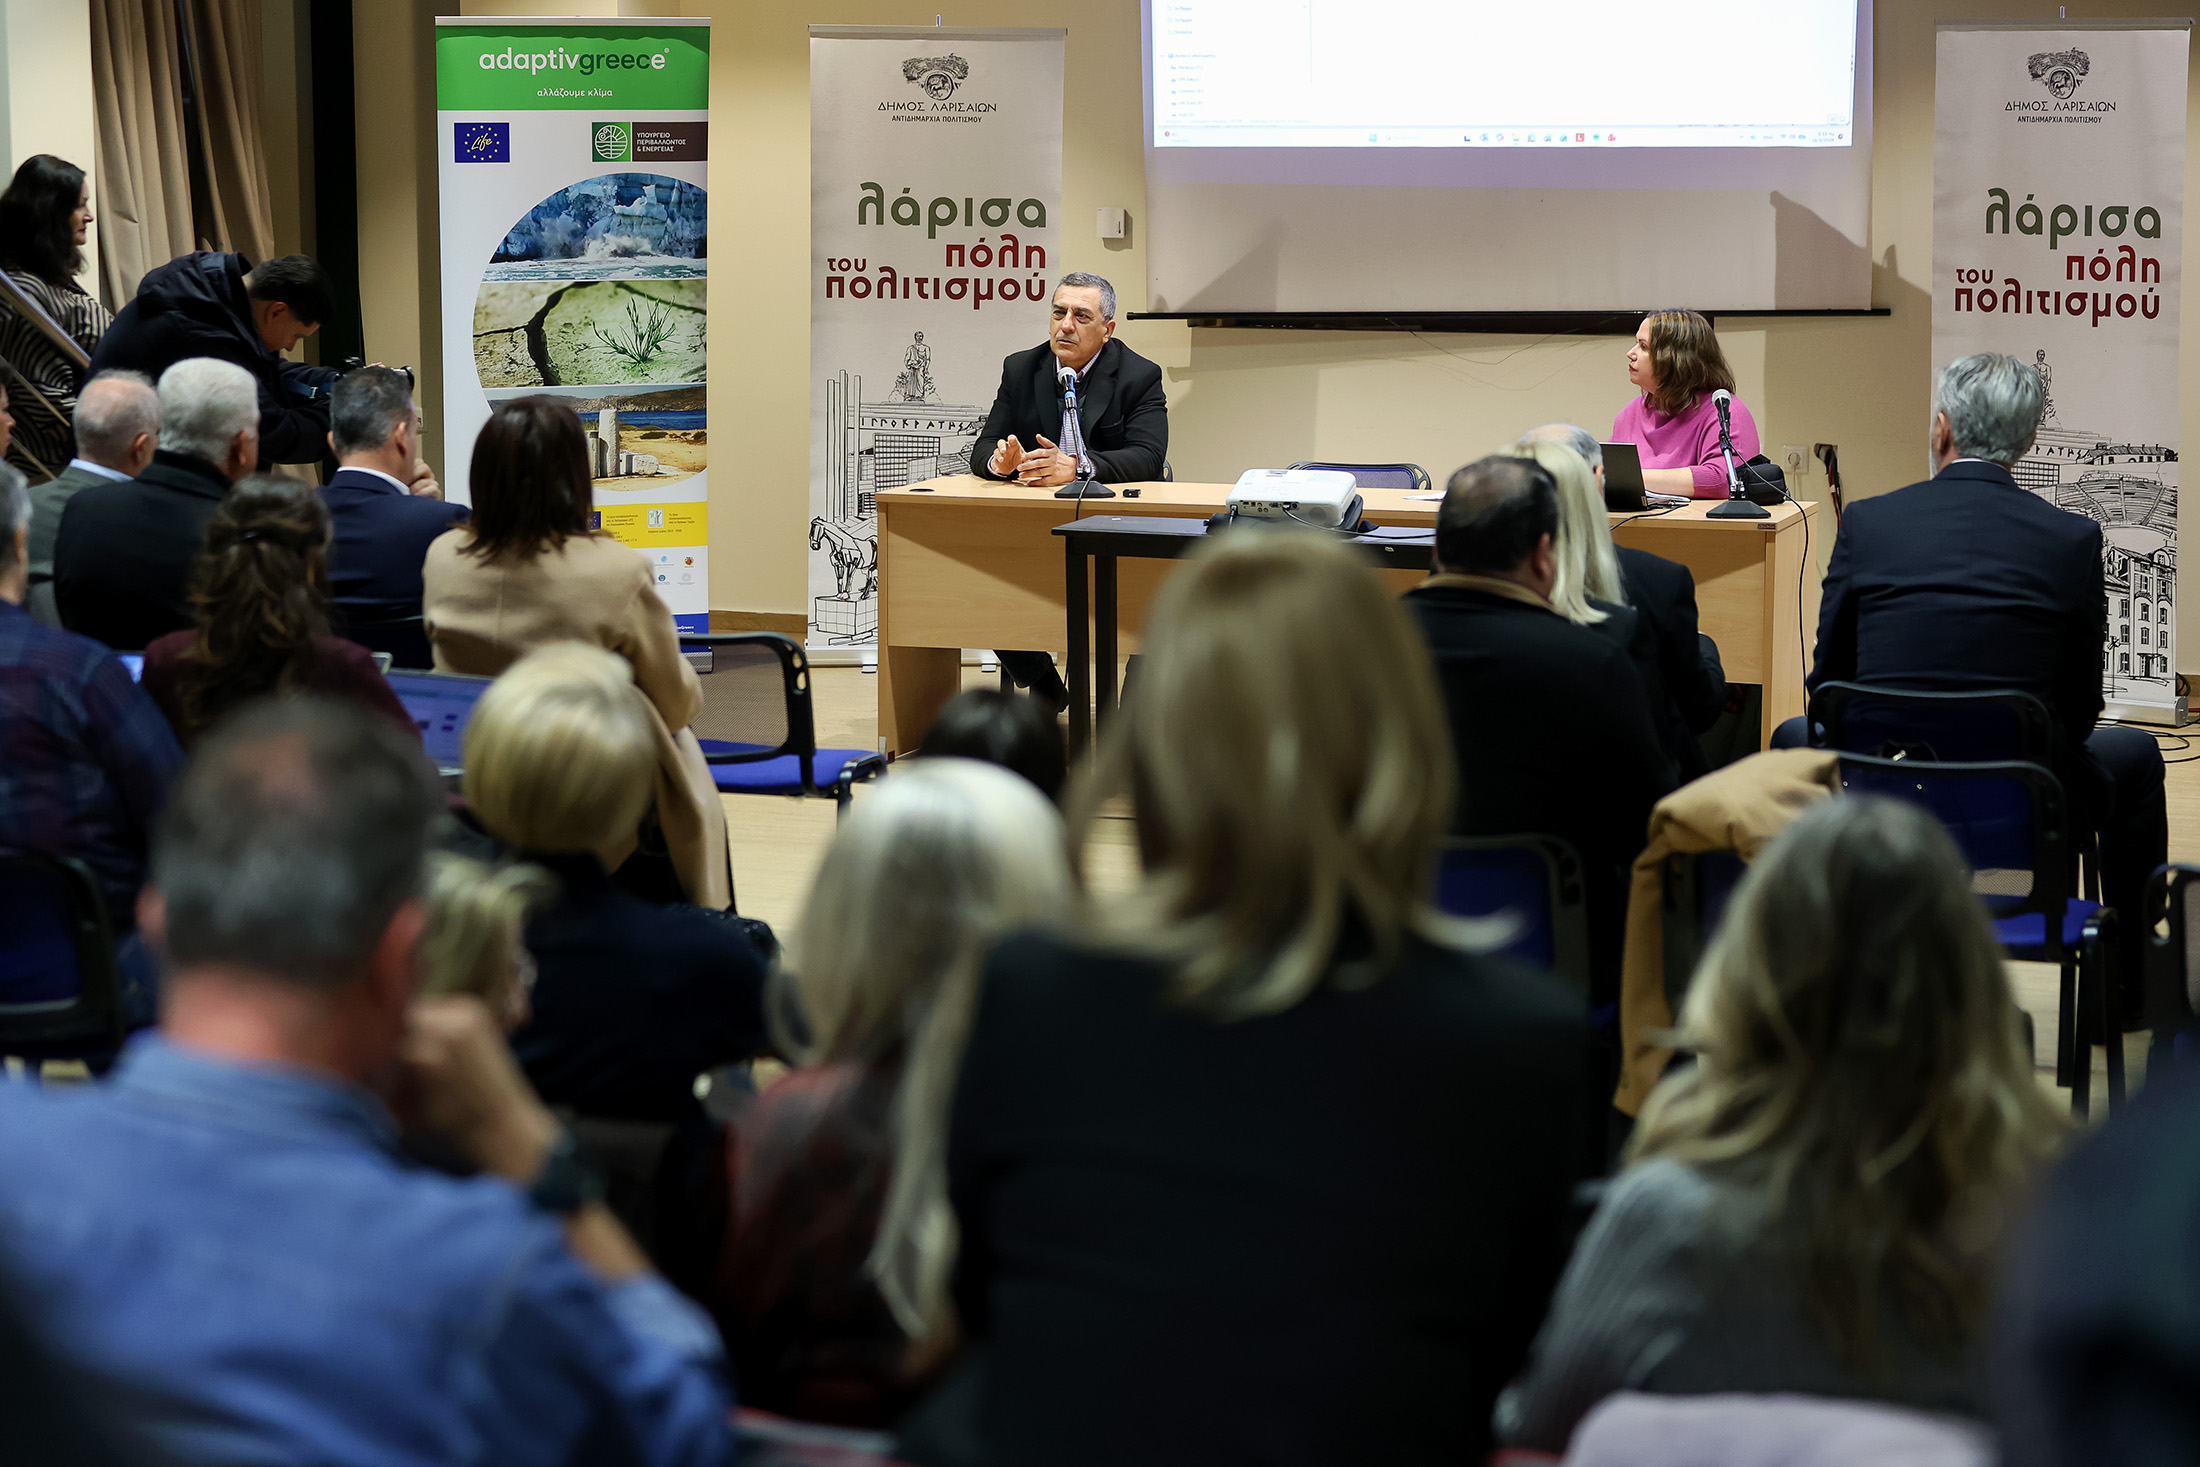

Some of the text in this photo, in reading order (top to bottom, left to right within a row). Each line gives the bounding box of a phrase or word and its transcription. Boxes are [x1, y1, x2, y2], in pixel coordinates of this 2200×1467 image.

[537, 88, 613, 98] αλλάζουμε κλίμα
[877, 101, 997, 113] ΔΗΜΟΣ ΛΑΡΙΣΑΙΩΝ
[2004, 101, 2116, 112] ΔΗΜΟΣ ΛΑΡΙΣΑΙΩΝ
[891, 114, 983, 123] ΑΝΤΙΔΗΜΑΡΧΙΑ ΠΟΛΙΤΙΣΜΟΥ
[2064, 116, 2102, 124] ΠΟΛΙΤΙΣΜΟΥ
[471, 132, 493, 152] Life
[858, 181, 1047, 240] λάρισα
[1986, 187, 2161, 250] λάρισα
[945, 233, 1046, 269] πόλη
[827, 257, 867, 272] του
[2066, 245, 2161, 284] πόλη
[1956, 268, 1993, 284] του
[826, 266, 1046, 310] πολιτισμού
[1954, 278, 2160, 328] πολιτισμού
